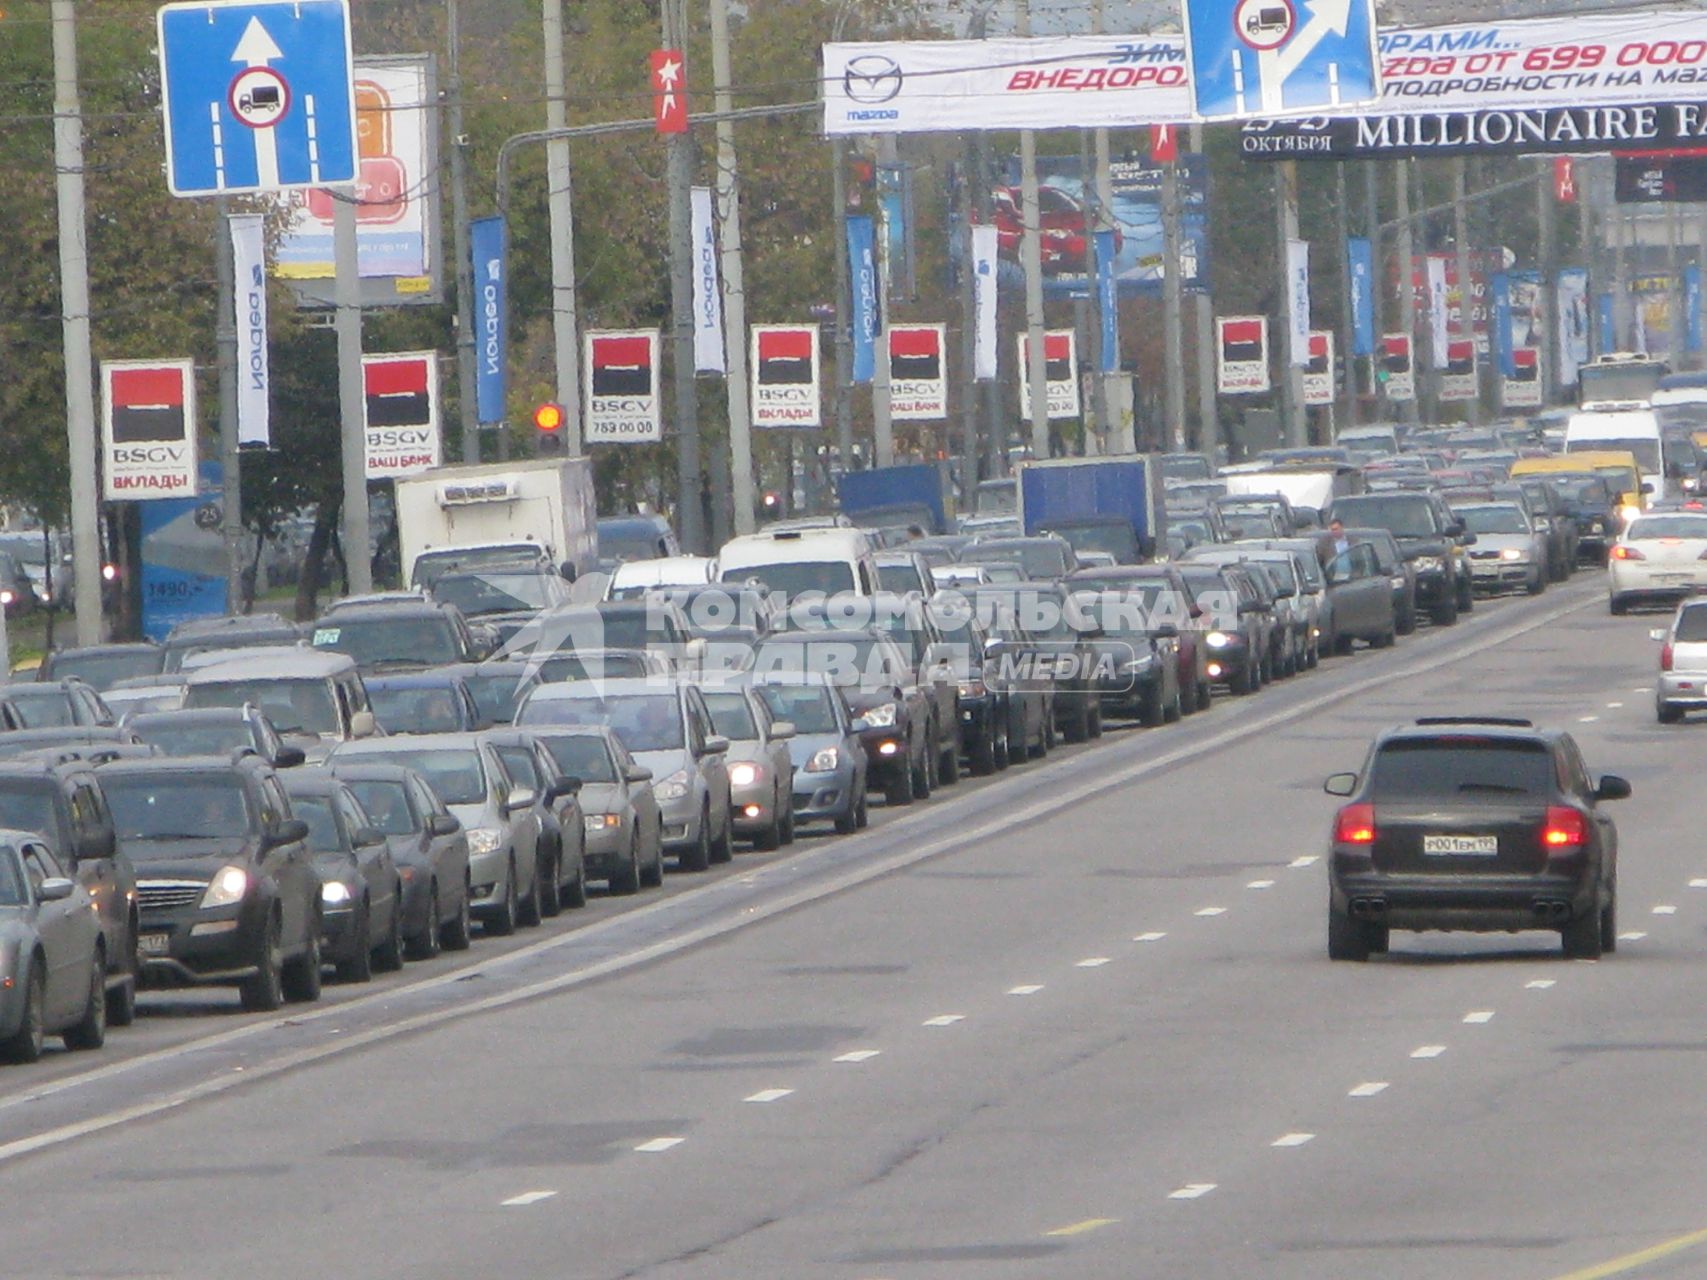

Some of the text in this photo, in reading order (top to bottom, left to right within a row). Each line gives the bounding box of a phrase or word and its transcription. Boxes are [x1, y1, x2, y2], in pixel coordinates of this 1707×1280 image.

[1464, 51, 1518, 75] ОТ
[1522, 45, 1606, 72] 699
[1616, 40, 1707, 67] 000
[1007, 65, 1189, 91] ВНЕДОРО
[1383, 71, 1602, 98] ПОДРОБНОСТИ
[1602, 69, 1643, 87] НА
[1356, 104, 1660, 148] MILLIONAIRE
[1242, 135, 1333, 153] ОКТЯБРЯ
[759, 389, 812, 400] BSGV
[367, 431, 431, 447] BSGV
[113, 447, 185, 464] BSGV
[367, 453, 433, 469] ВАШ БАНК
[113, 474, 188, 490] ВКЛАДЫ
